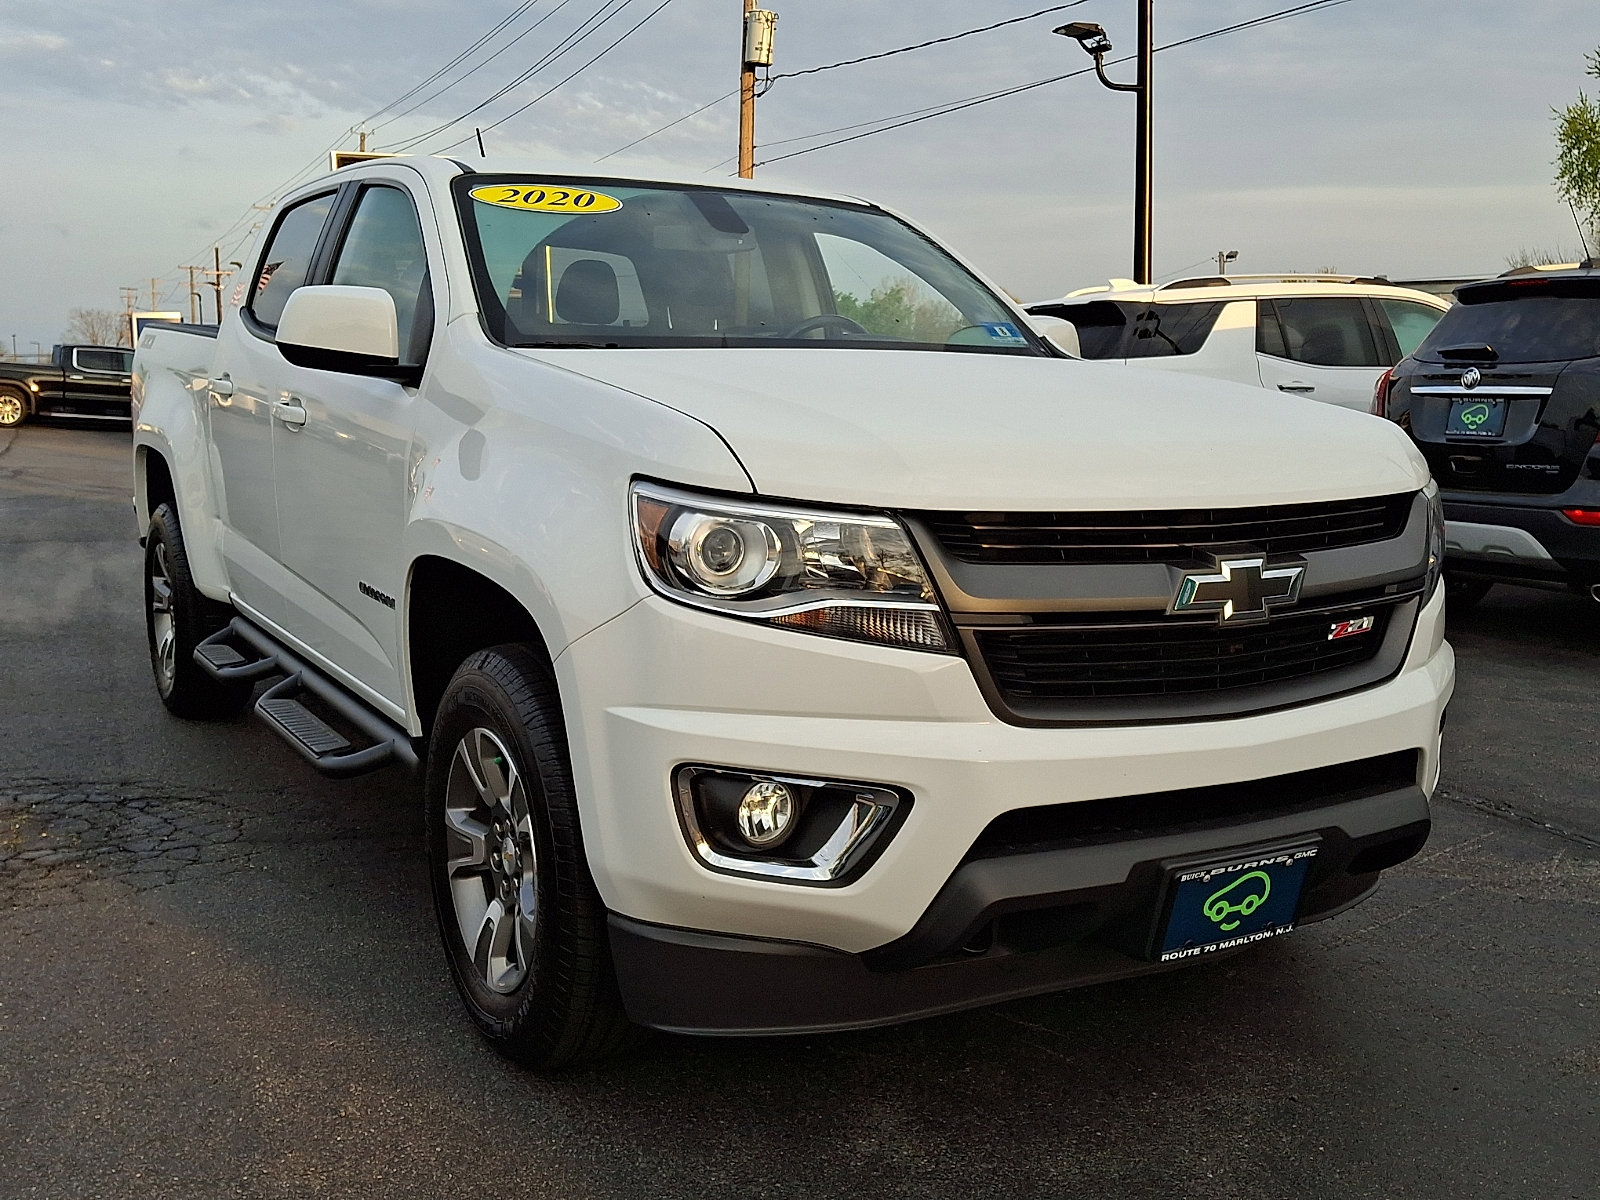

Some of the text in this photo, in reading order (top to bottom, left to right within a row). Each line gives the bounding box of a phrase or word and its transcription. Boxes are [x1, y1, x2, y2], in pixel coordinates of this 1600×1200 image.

[496, 189, 595, 207] 2020
[1328, 616, 1374, 640] Z71
[1181, 849, 1318, 882] BUICK BURNS GMC
[1161, 925, 1293, 962] ROUTE 70 MARLTON, N.J.
